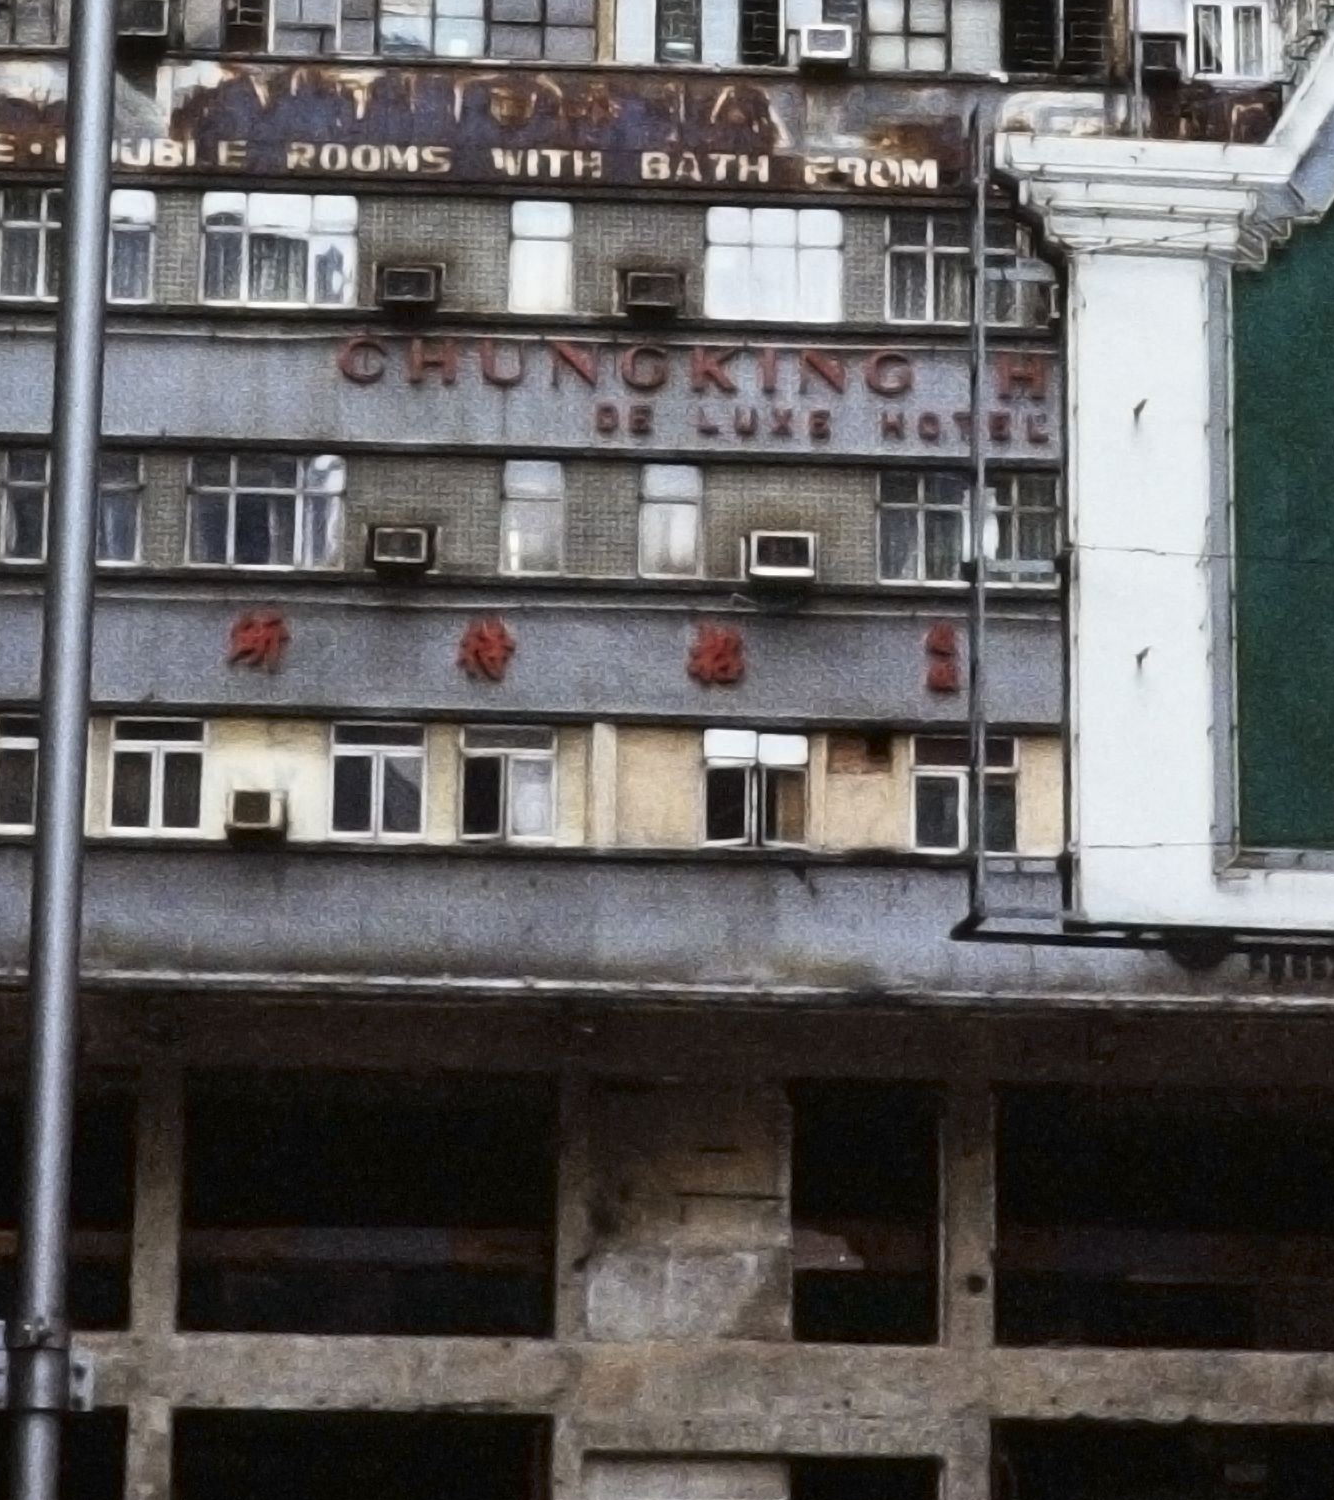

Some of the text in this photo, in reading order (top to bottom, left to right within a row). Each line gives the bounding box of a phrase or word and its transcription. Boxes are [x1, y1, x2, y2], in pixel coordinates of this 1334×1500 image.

[55, 138, 247, 169] UBLE
[286, 141, 452, 175] ROOMS
[490, 147, 604, 180] WITH
[640, 151, 769, 184] BATH
[804, 156, 939, 189] FROM
[337, 335, 914, 396] CHUNGKING
[595, 403, 1052, 446] DE LUXE HOTEL
